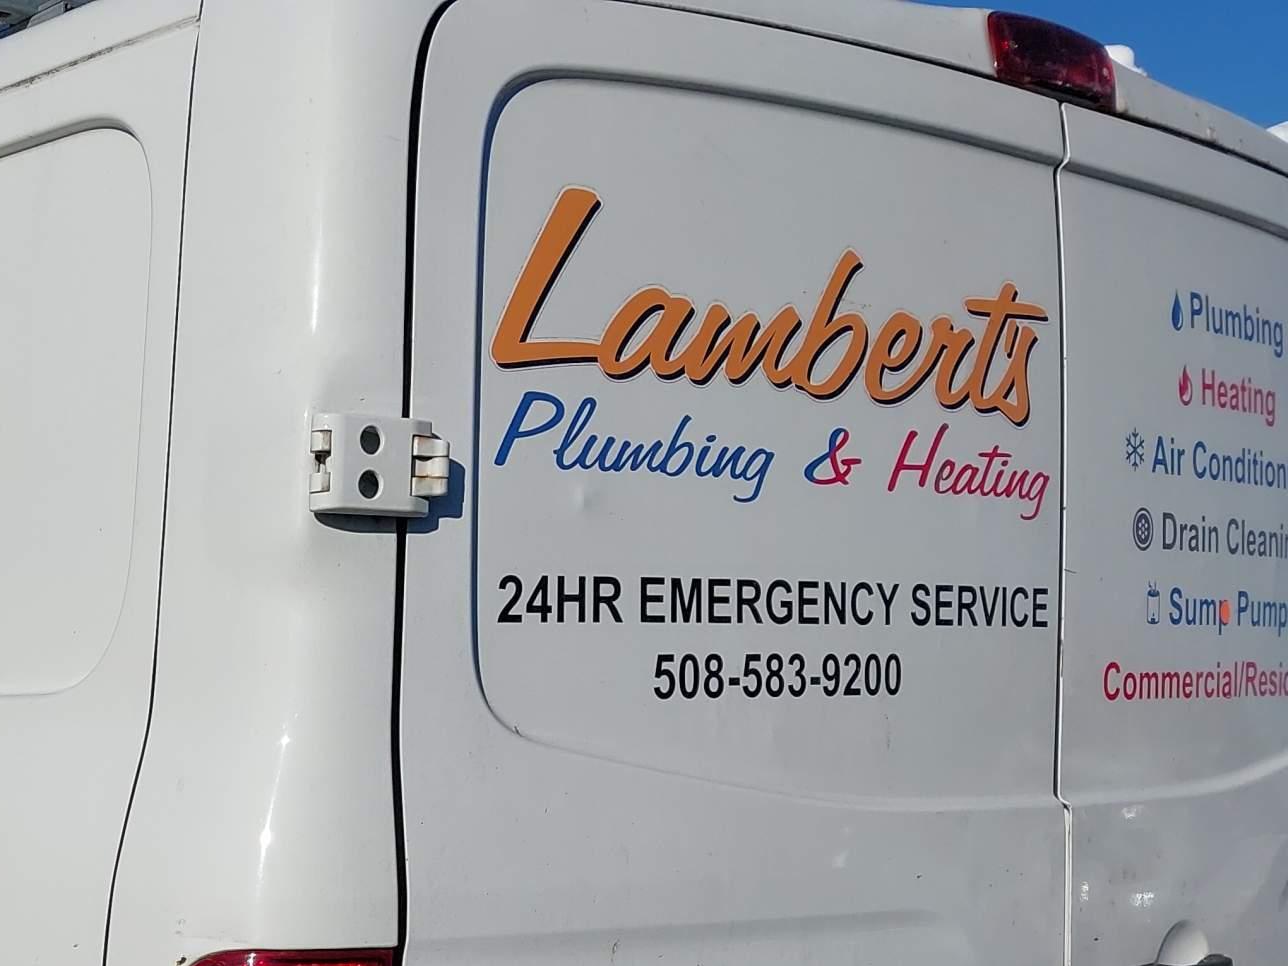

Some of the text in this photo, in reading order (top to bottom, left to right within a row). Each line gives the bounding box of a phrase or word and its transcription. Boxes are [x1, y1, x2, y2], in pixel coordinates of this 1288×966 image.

[1189, 291, 1284, 358] Plumbing
[1201, 367, 1276, 427] Heating
[493, 390, 1050, 521] Plumbing & Heating
[1151, 435, 1186, 476] Air
[1162, 512, 1219, 554] Drain
[496, 574, 1049, 628] 24HR EMERGENCY SERVICE
[1169, 587, 1288, 637] Sump Pump
[653, 652, 902, 701] 508-583-9200
